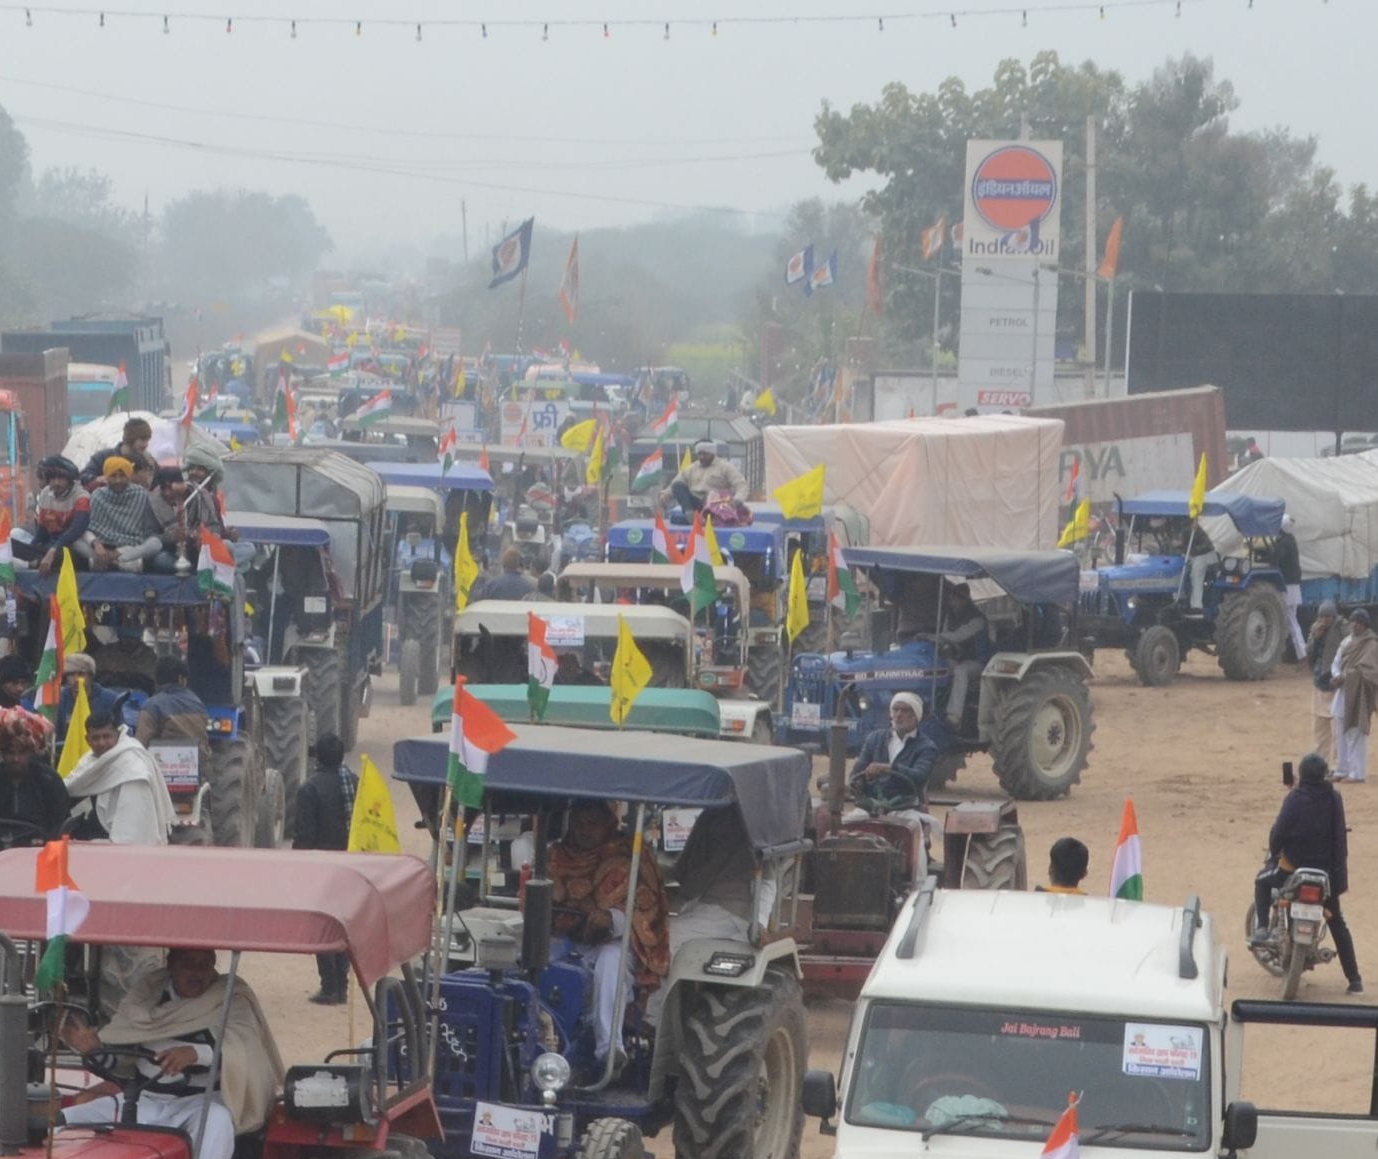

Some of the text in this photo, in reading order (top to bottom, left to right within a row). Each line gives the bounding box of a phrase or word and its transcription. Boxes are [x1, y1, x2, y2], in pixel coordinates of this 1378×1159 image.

[969, 237, 1055, 256] IndiaOil
[989, 317, 1028, 328] PETROL
[989, 367, 1025, 378] DIESEL
[980, 391, 1032, 406] SERVO
[874, 669, 925, 679] FARMTRAC
[1001, 1021, 1081, 1039] Jai Bajrang Bali
